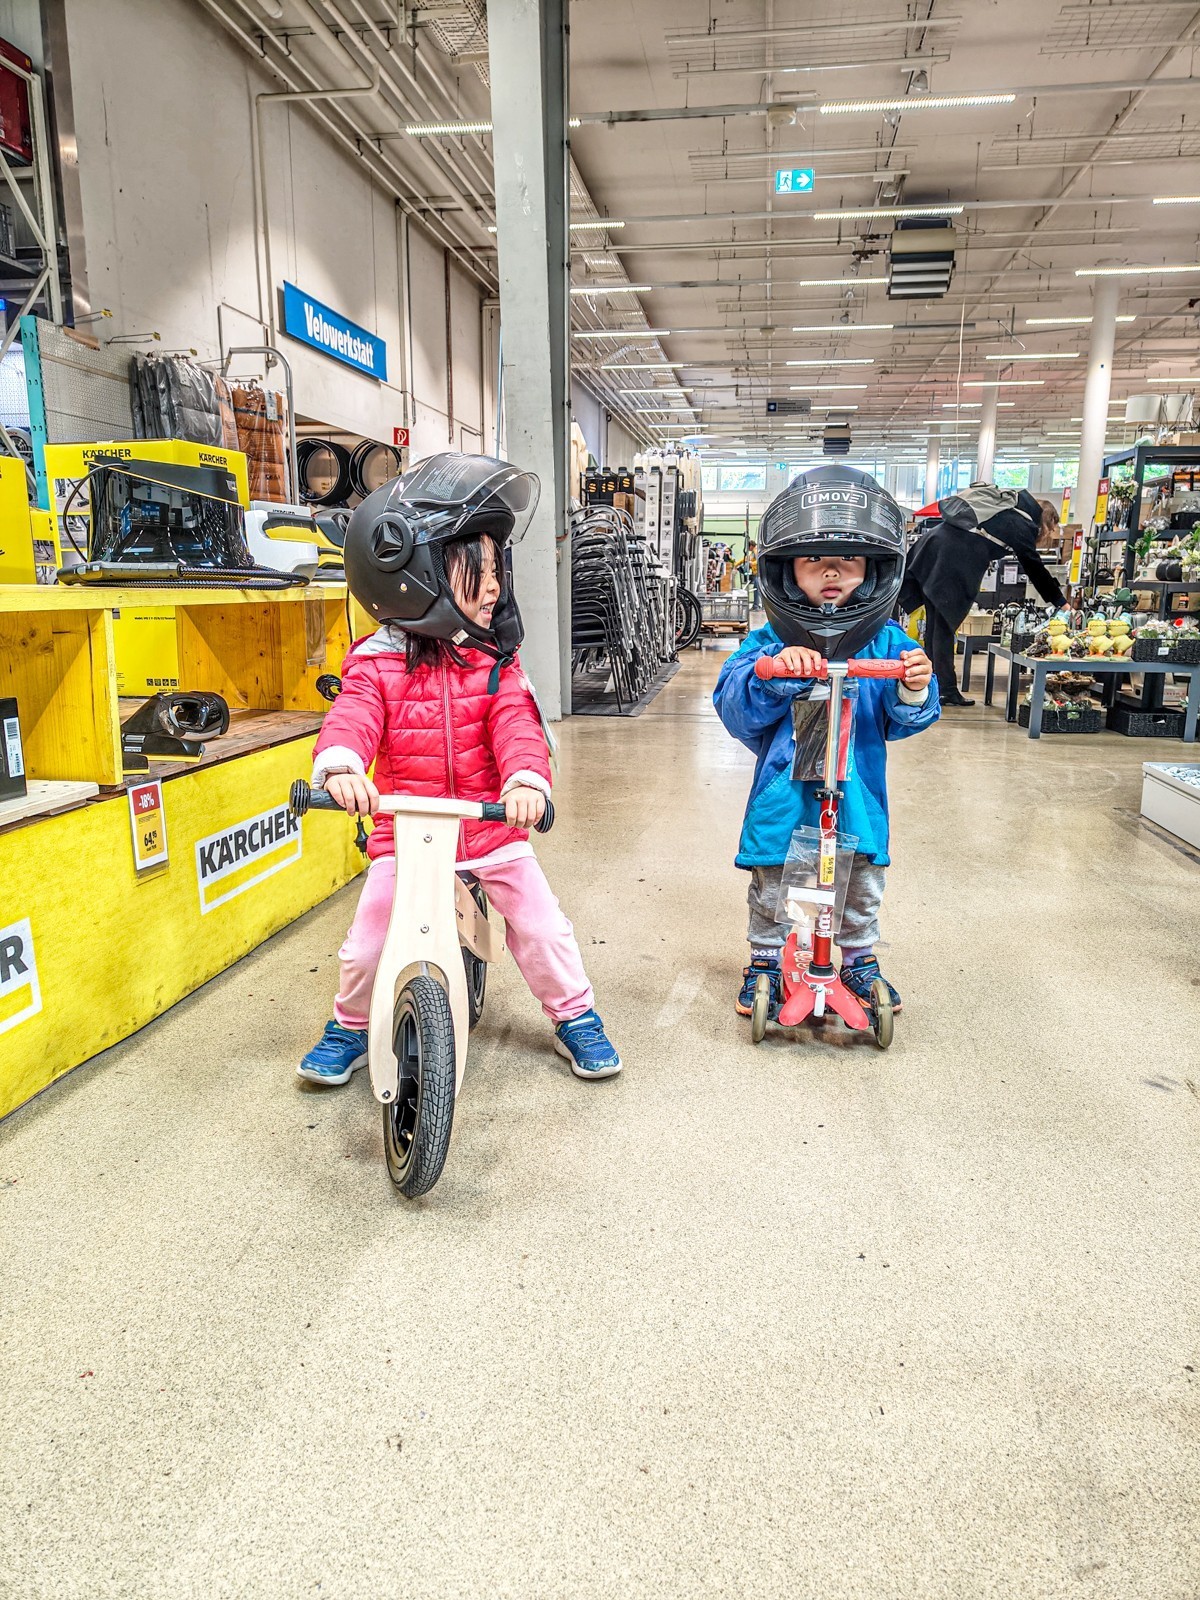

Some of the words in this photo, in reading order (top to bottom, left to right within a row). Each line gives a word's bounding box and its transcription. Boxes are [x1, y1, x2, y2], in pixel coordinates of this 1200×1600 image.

[303, 301, 374, 370] Velowerkstatt
[198, 452, 228, 466] KÄRCHER
[807, 492, 861, 504] UMOVE
[138, 792, 154, 808] -18%
[199, 808, 300, 879] KÄRCHER
